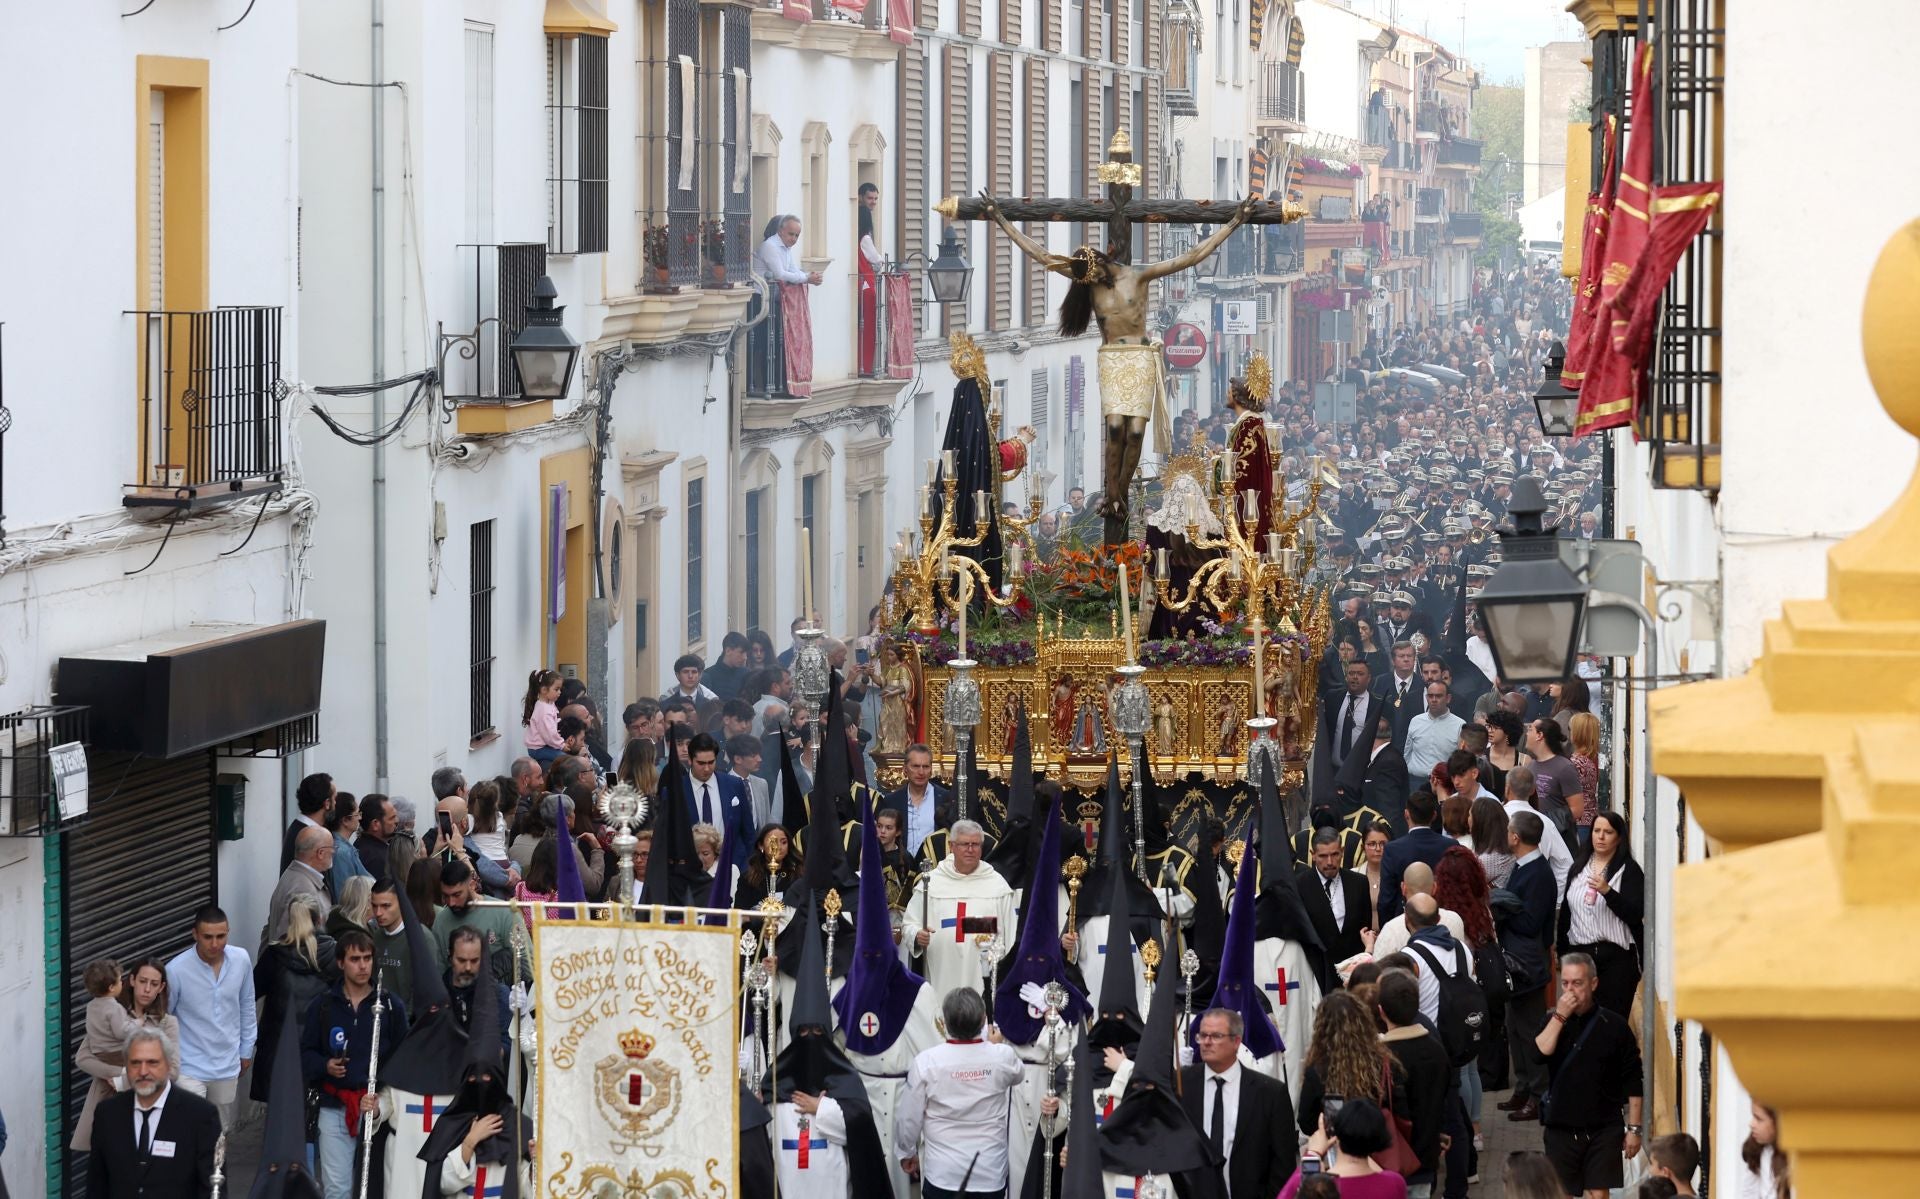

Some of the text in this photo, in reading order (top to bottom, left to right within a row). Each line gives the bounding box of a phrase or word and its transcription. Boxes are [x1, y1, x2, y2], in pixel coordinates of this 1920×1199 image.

[1168, 347, 1201, 355] Cruzcampo
[53, 748, 87, 775] SE VENDE
[550, 945, 617, 981] Gloria
[624, 945, 647, 966] al
[555, 972, 618, 1010] Gloria
[625, 971, 648, 992] al
[551, 1009, 599, 1070] Gloria
[600, 994, 621, 1019] al
